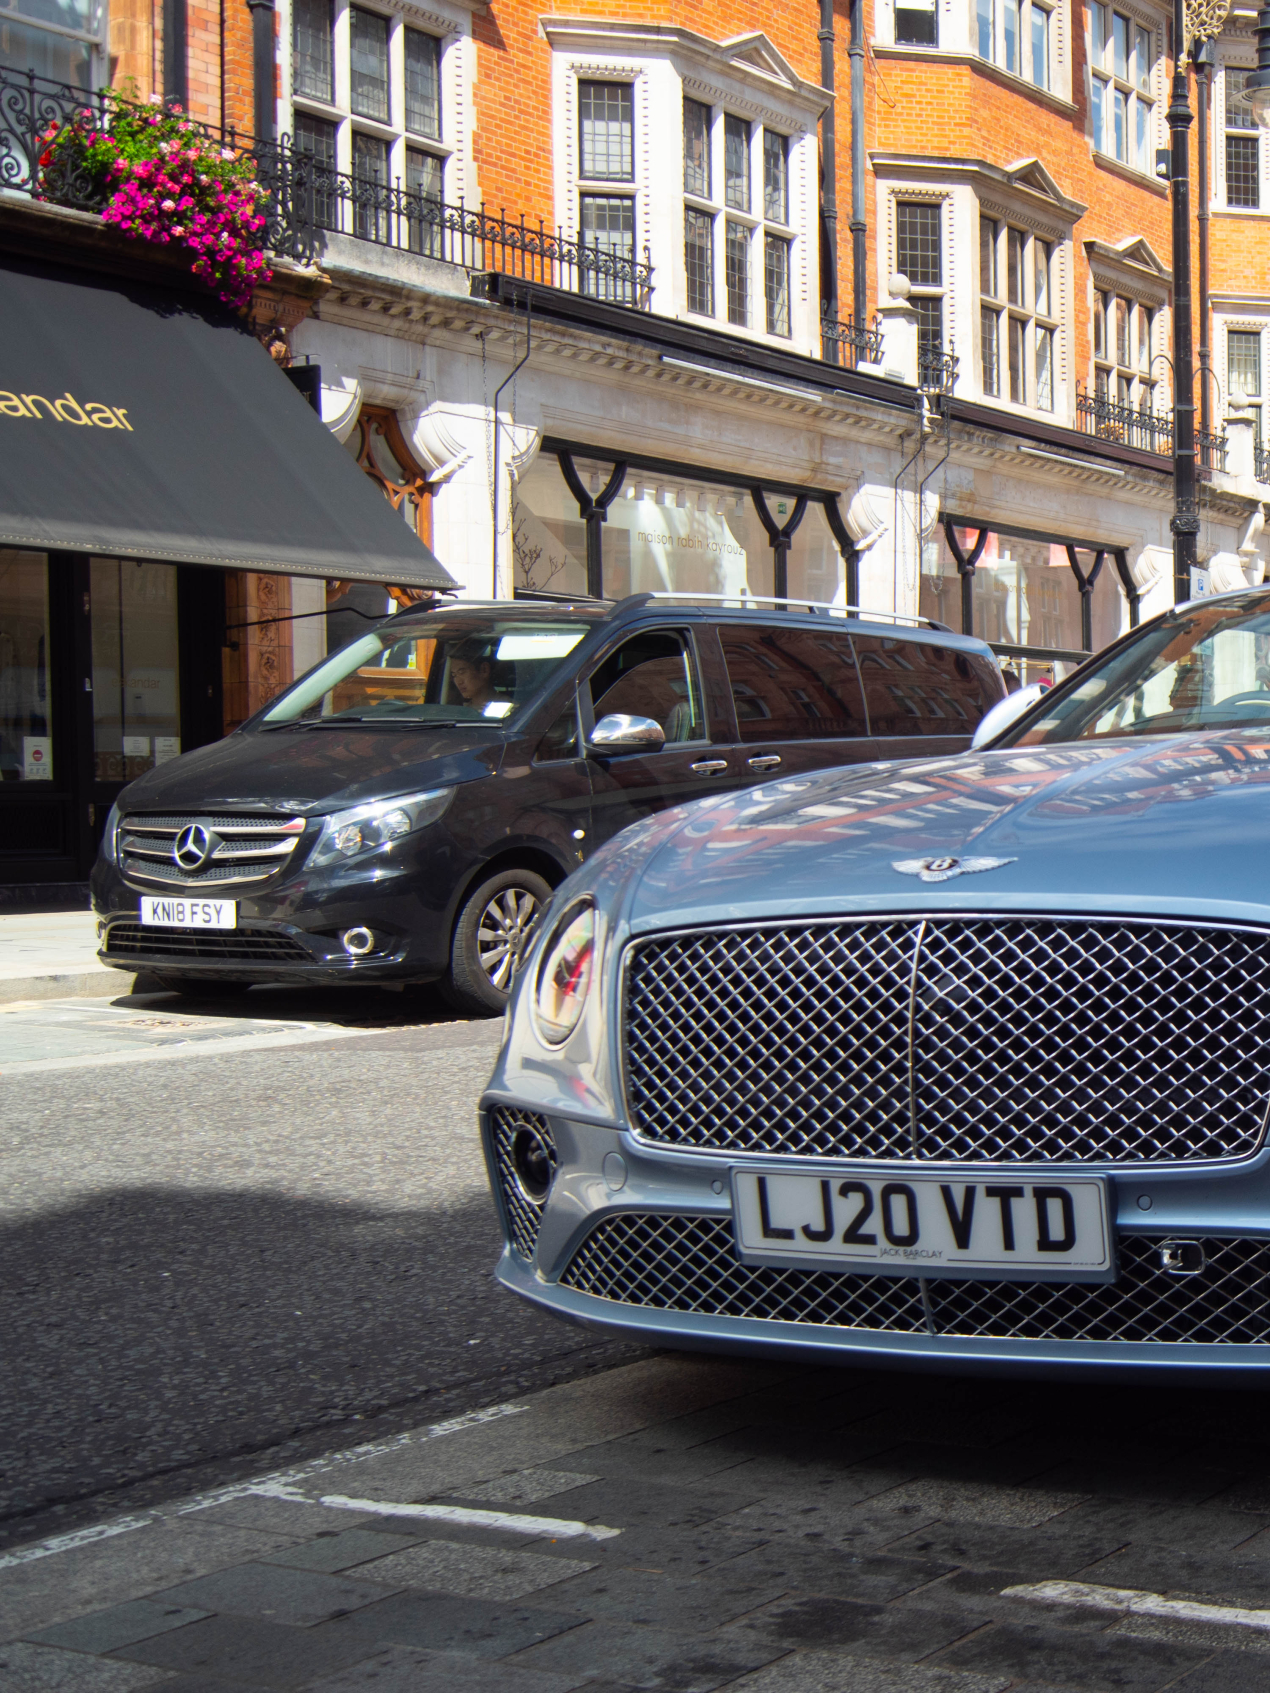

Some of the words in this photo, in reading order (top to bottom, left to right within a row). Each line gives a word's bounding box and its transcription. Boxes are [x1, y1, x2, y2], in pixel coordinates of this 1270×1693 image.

[0, 391, 134, 431] andar
[637, 530, 673, 546] maison
[677, 534, 703, 549] rabih
[707, 537, 744, 556] kayrouz
[152, 901, 186, 923] KN18
[190, 903, 223, 924] FSY
[757, 1176, 920, 1247] LJ20
[940, 1184, 1077, 1252] VTD
[879, 1247, 901, 1258] JACK
[903, 1249, 943, 1259] BARCLAY
